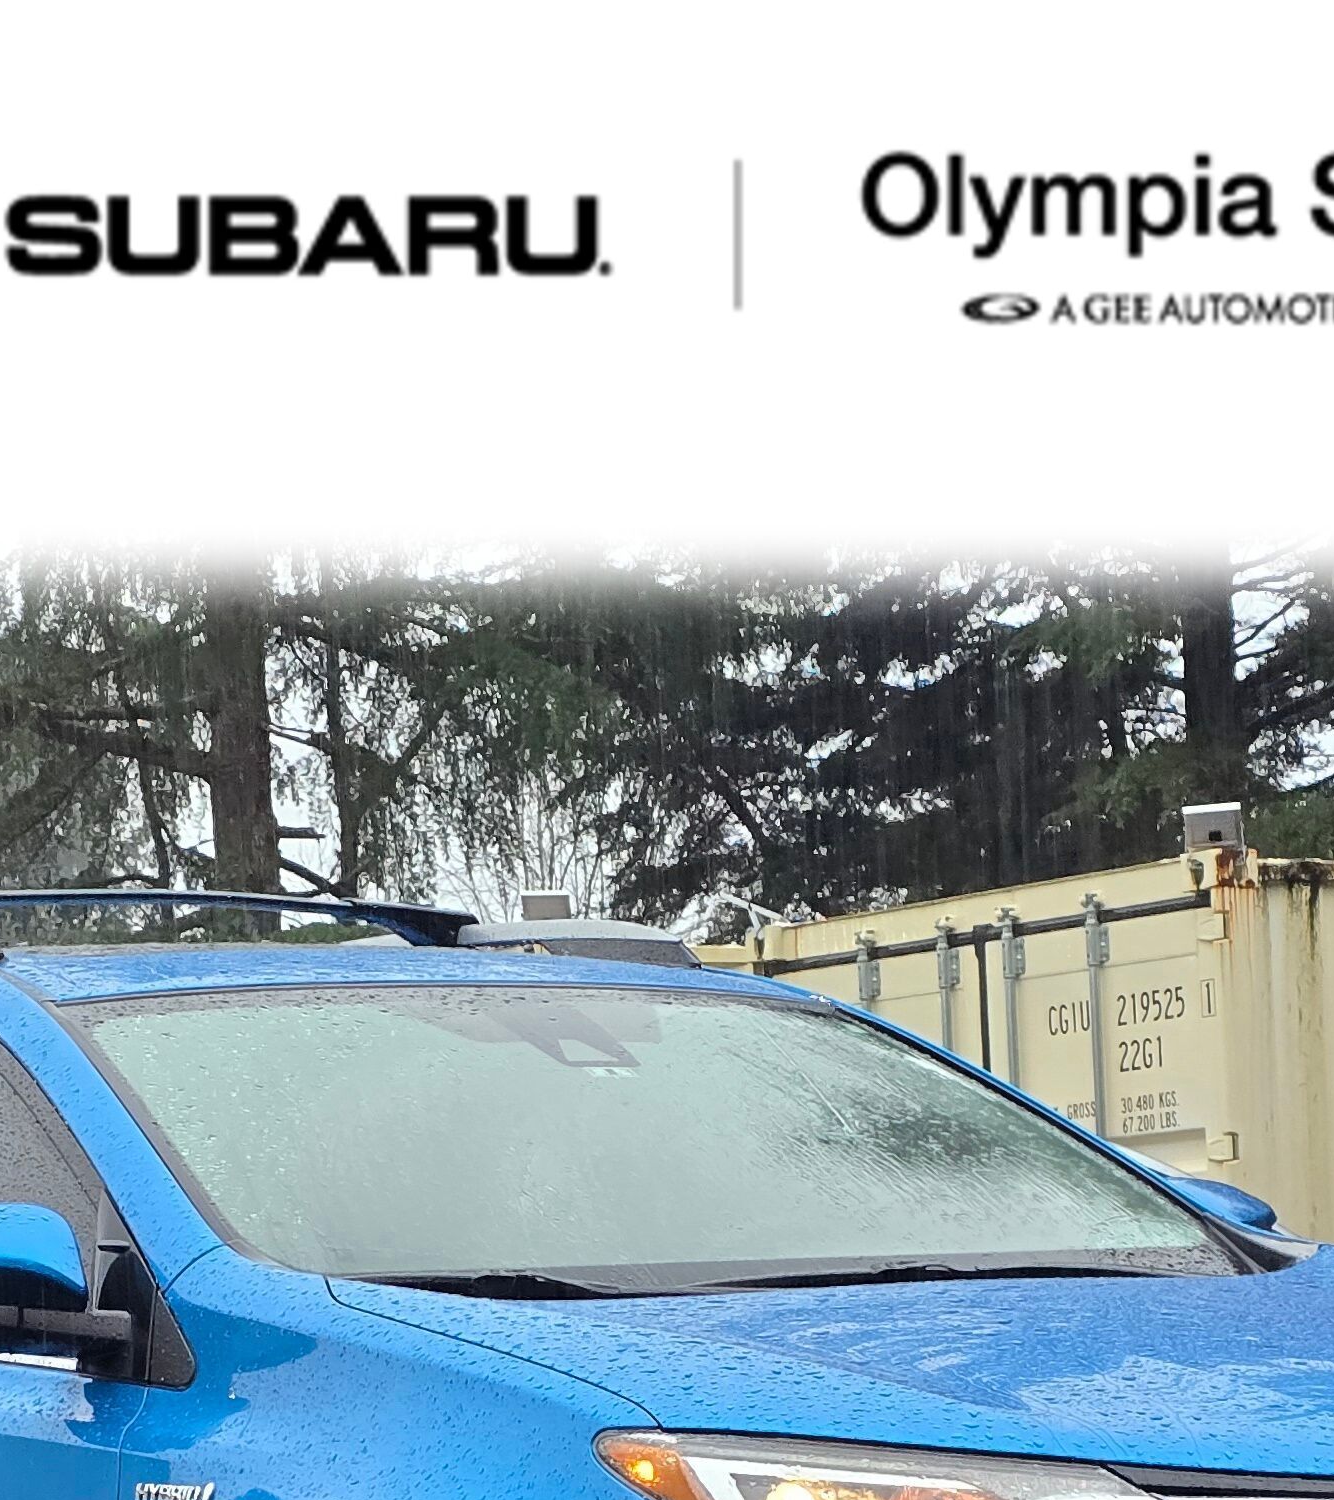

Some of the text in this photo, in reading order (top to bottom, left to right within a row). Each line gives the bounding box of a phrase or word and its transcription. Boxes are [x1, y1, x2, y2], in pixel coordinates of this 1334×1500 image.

[1048, 1000, 1091, 1036] CGIU
[1116, 986, 1186, 1027] 219525
[1118, 1035, 1163, 1073] 22G1
[1067, 1101, 1096, 1121] GROSS
